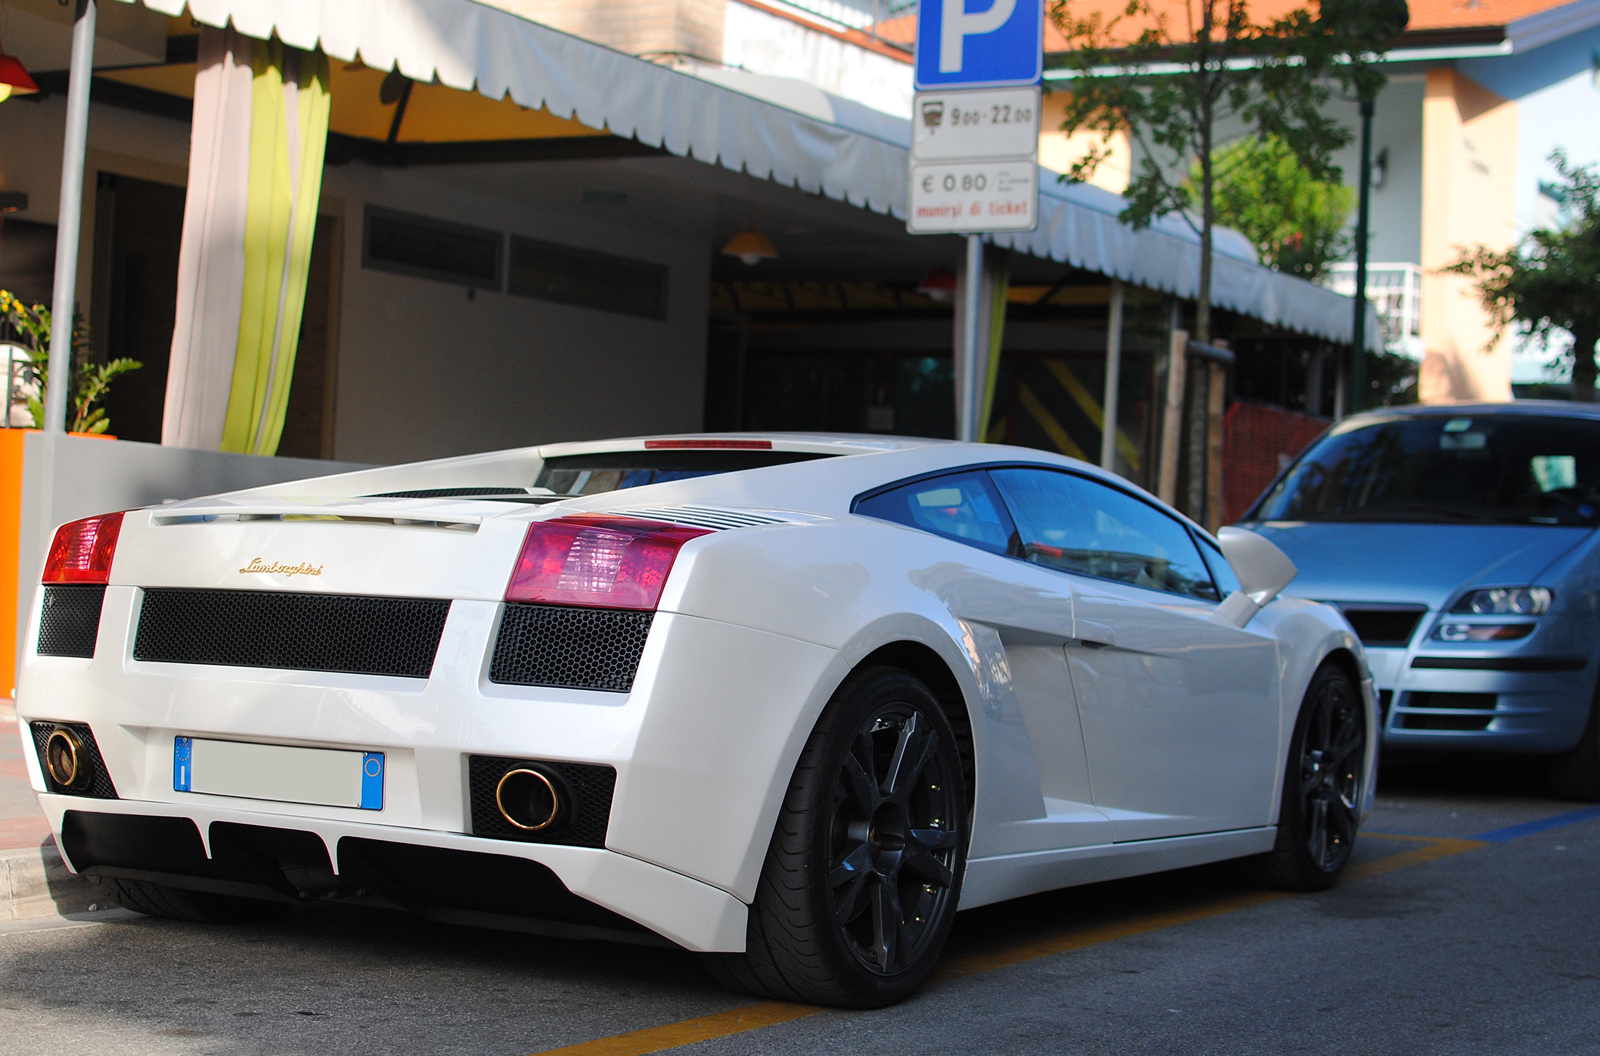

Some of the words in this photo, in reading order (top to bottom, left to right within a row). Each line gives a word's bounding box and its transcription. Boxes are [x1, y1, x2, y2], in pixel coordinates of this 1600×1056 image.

[939, 0, 1017, 73] P
[922, 175, 934, 193] €
[943, 174, 987, 192] 0.80
[970, 202, 981, 216] di
[990, 202, 1027, 215] ticket
[239, 557, 324, 577] Lamborghini
